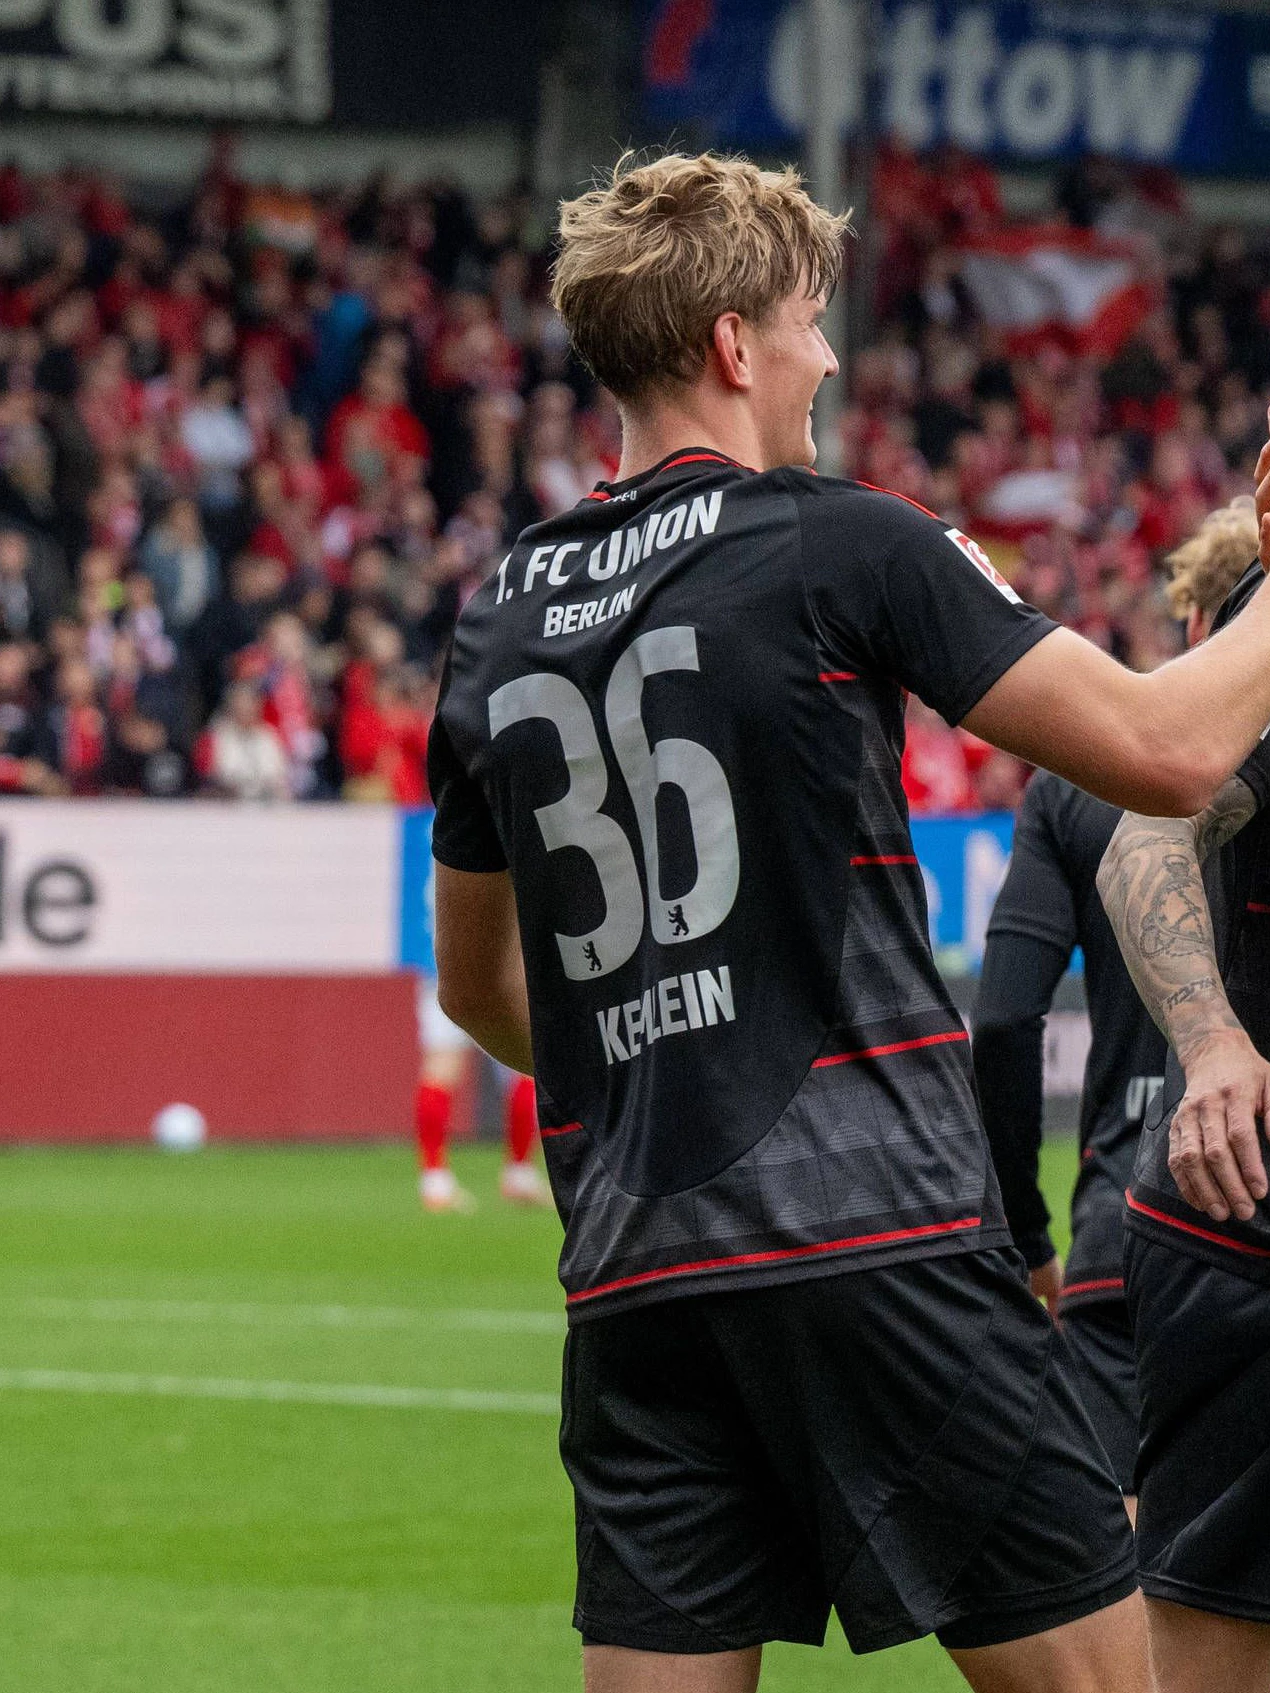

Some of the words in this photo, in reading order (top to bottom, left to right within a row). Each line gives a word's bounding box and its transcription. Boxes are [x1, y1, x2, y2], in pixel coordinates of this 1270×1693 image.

[522, 542, 584, 594] FC
[587, 490, 724, 582] UNION
[542, 583, 639, 638] BERLIN
[488, 626, 741, 982] 36
